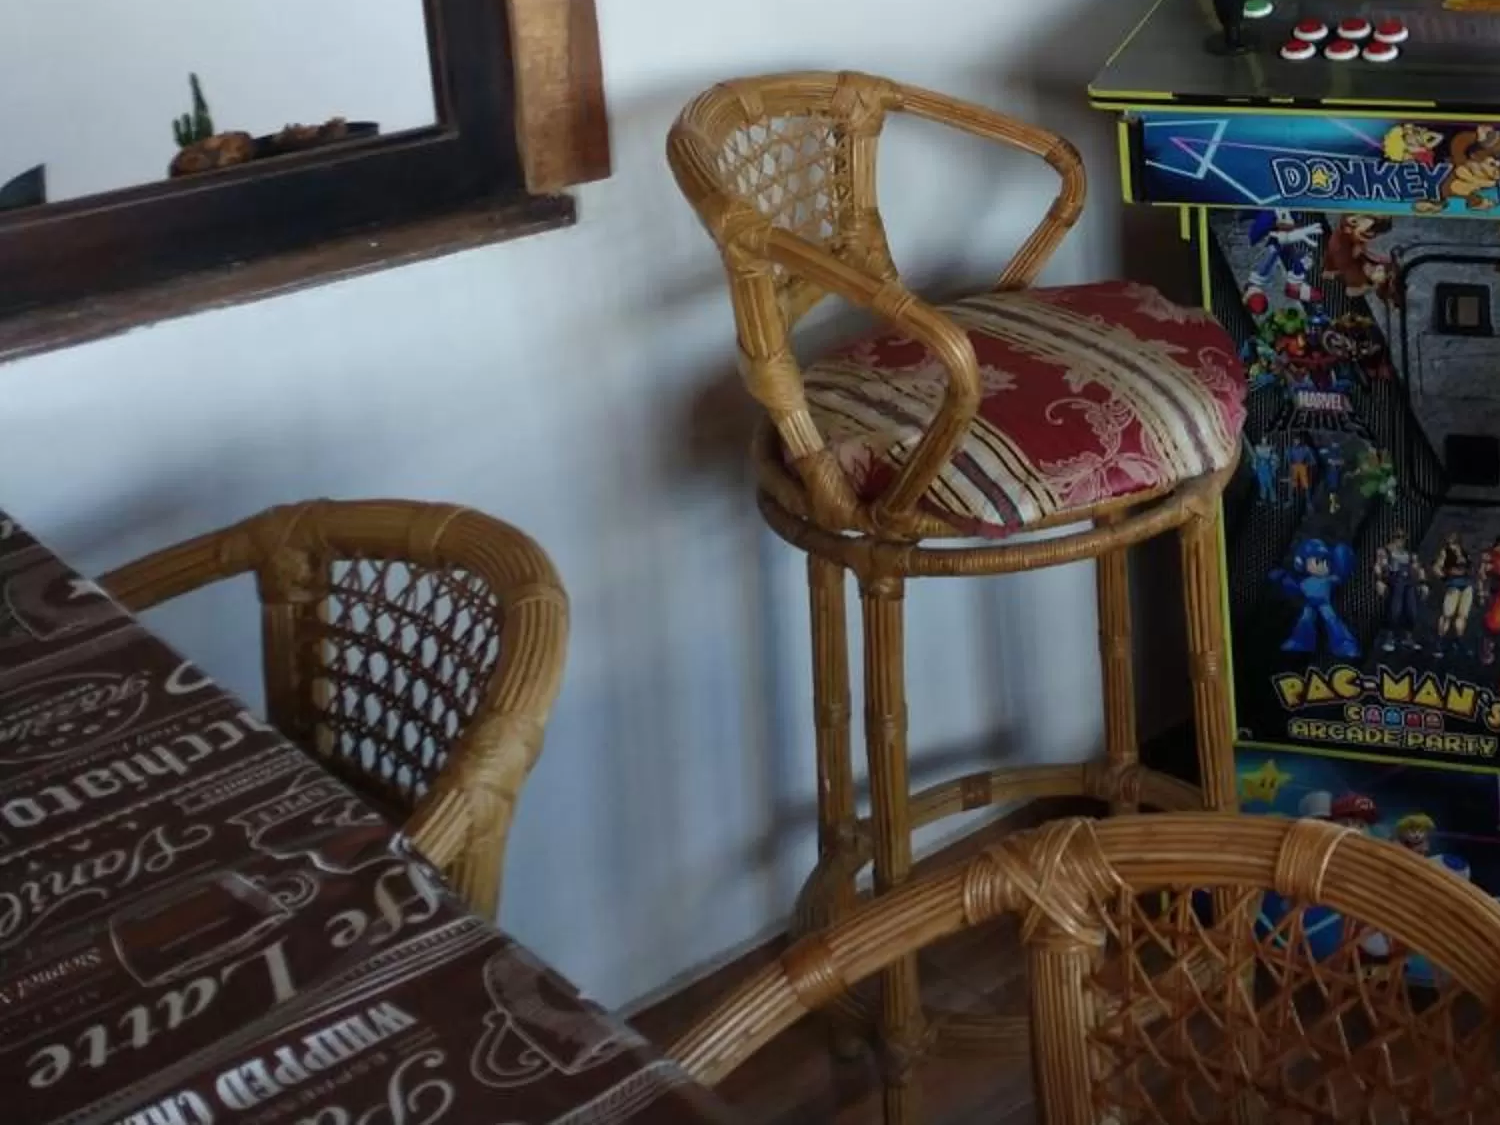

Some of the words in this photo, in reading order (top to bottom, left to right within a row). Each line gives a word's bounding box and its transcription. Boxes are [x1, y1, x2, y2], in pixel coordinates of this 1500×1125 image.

[1272, 157, 1454, 202] DONKEY
[1297, 389, 1346, 411] MARVEL
[1288, 717, 1402, 745] ARCADE
[1405, 731, 1499, 757] PARTY
[27, 943, 298, 1088] Latte
[215, 999, 418, 1111] WHIPPED
